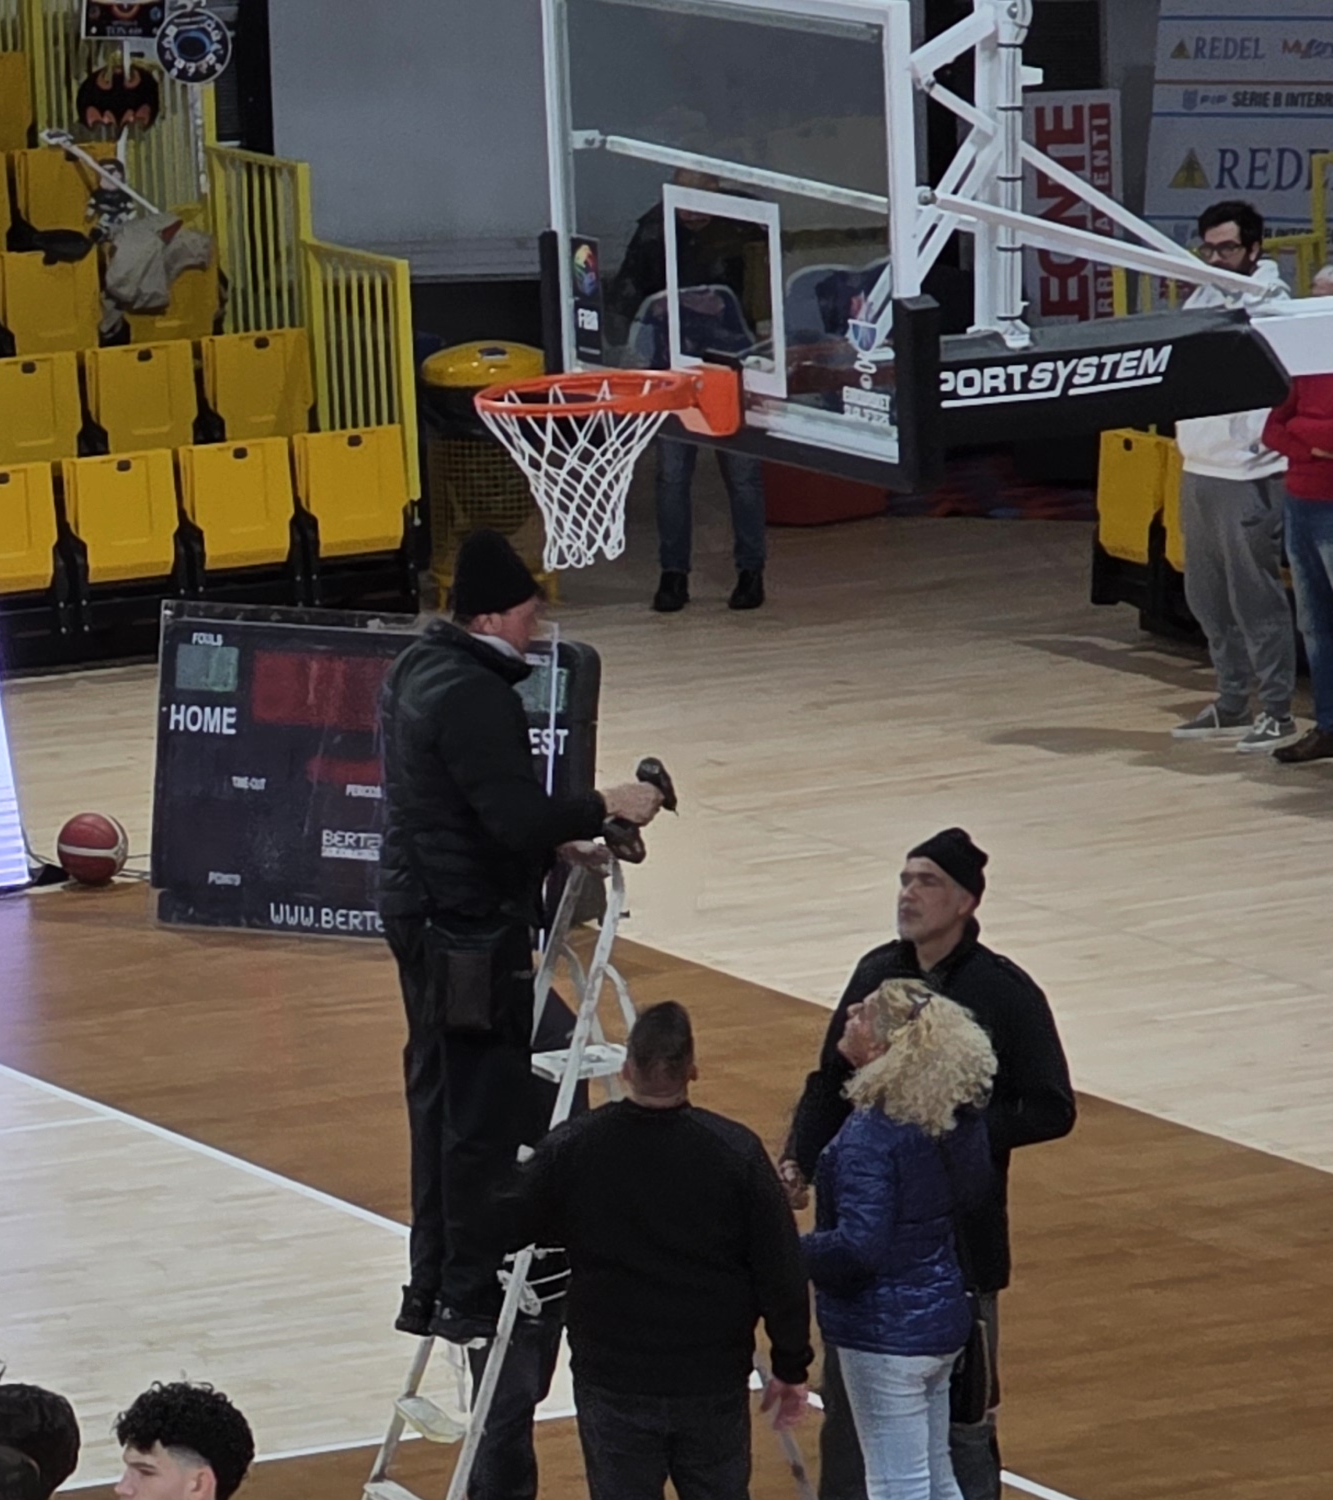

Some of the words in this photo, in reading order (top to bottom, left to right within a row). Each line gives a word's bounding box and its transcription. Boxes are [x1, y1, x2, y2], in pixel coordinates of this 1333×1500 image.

[1193, 36, 1266, 60] REDEL
[169, 703, 237, 735] HOME
[528, 727, 569, 756] EST
